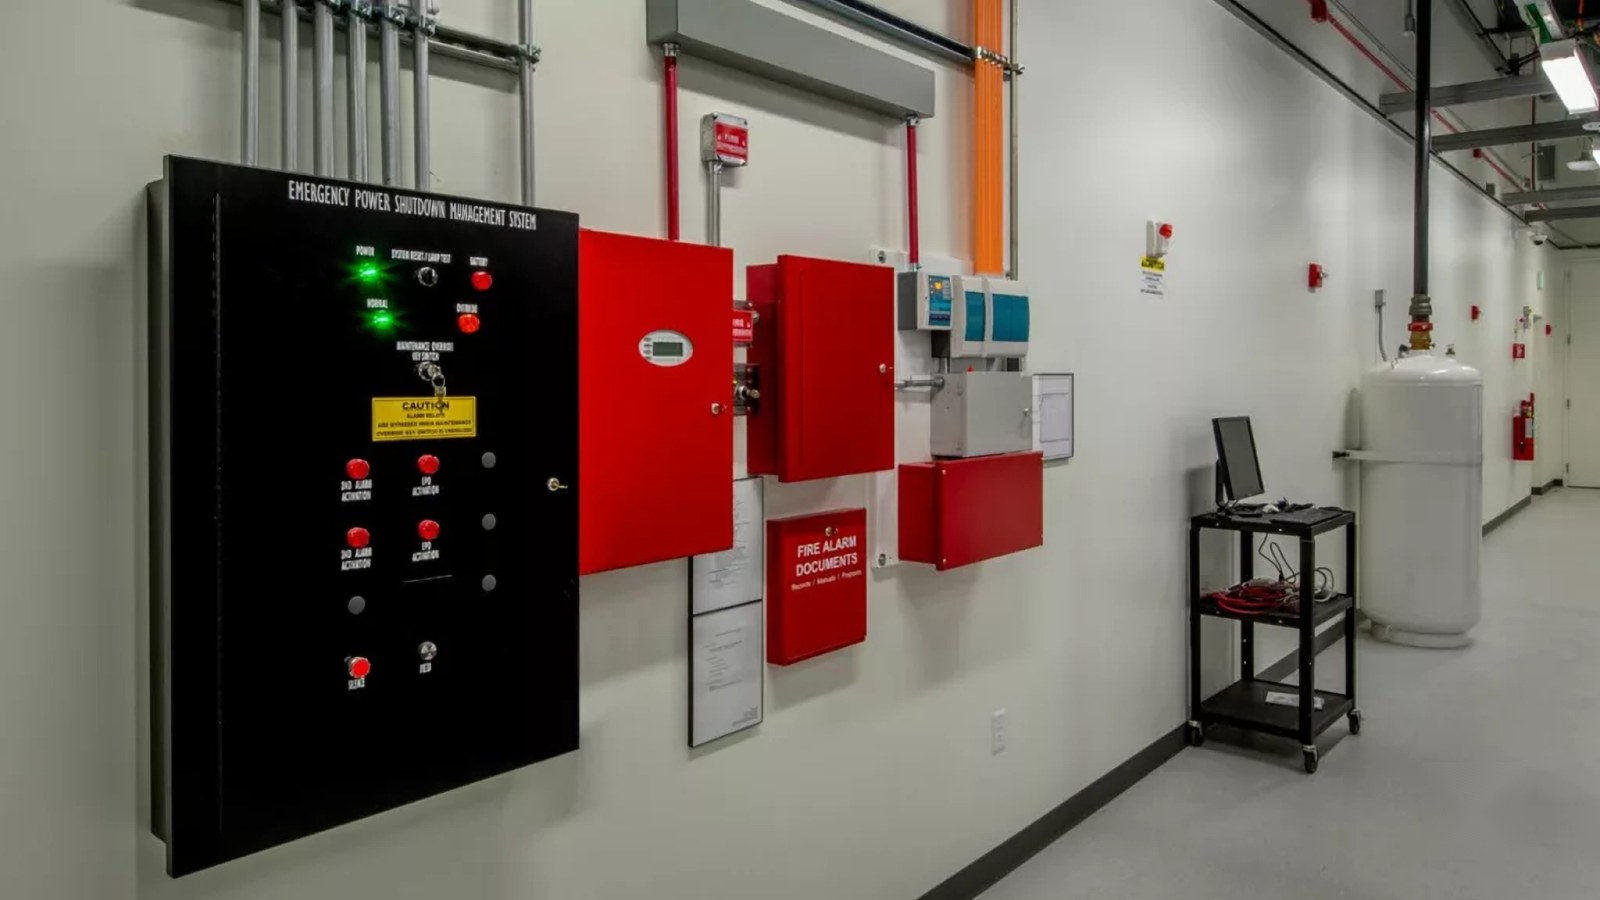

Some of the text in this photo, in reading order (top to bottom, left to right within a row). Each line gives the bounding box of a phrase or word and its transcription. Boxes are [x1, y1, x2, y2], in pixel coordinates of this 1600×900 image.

[288, 180, 537, 231] EMERGENCY POWER SHUTDOWN MANAGEMENT SYSTEM
[355, 245, 375, 257] POWER
[366, 298, 389, 309] NORMAL
[396, 341, 454, 352] MAINTENANCE OVERRIDE
[402, 401, 450, 411] CAUTION
[355, 479, 373, 490] ALARM
[412, 485, 440, 496] ACTIVATION
[341, 491, 371, 502] ACTIVATION
[797, 535, 857, 558] FIRE ALARM
[355, 547, 373, 558] ALARM
[412, 549, 440, 562] ACTIVATION
[341, 559, 371, 571] ACTIVATION
[796, 552, 858, 577] DOCUMENTS
